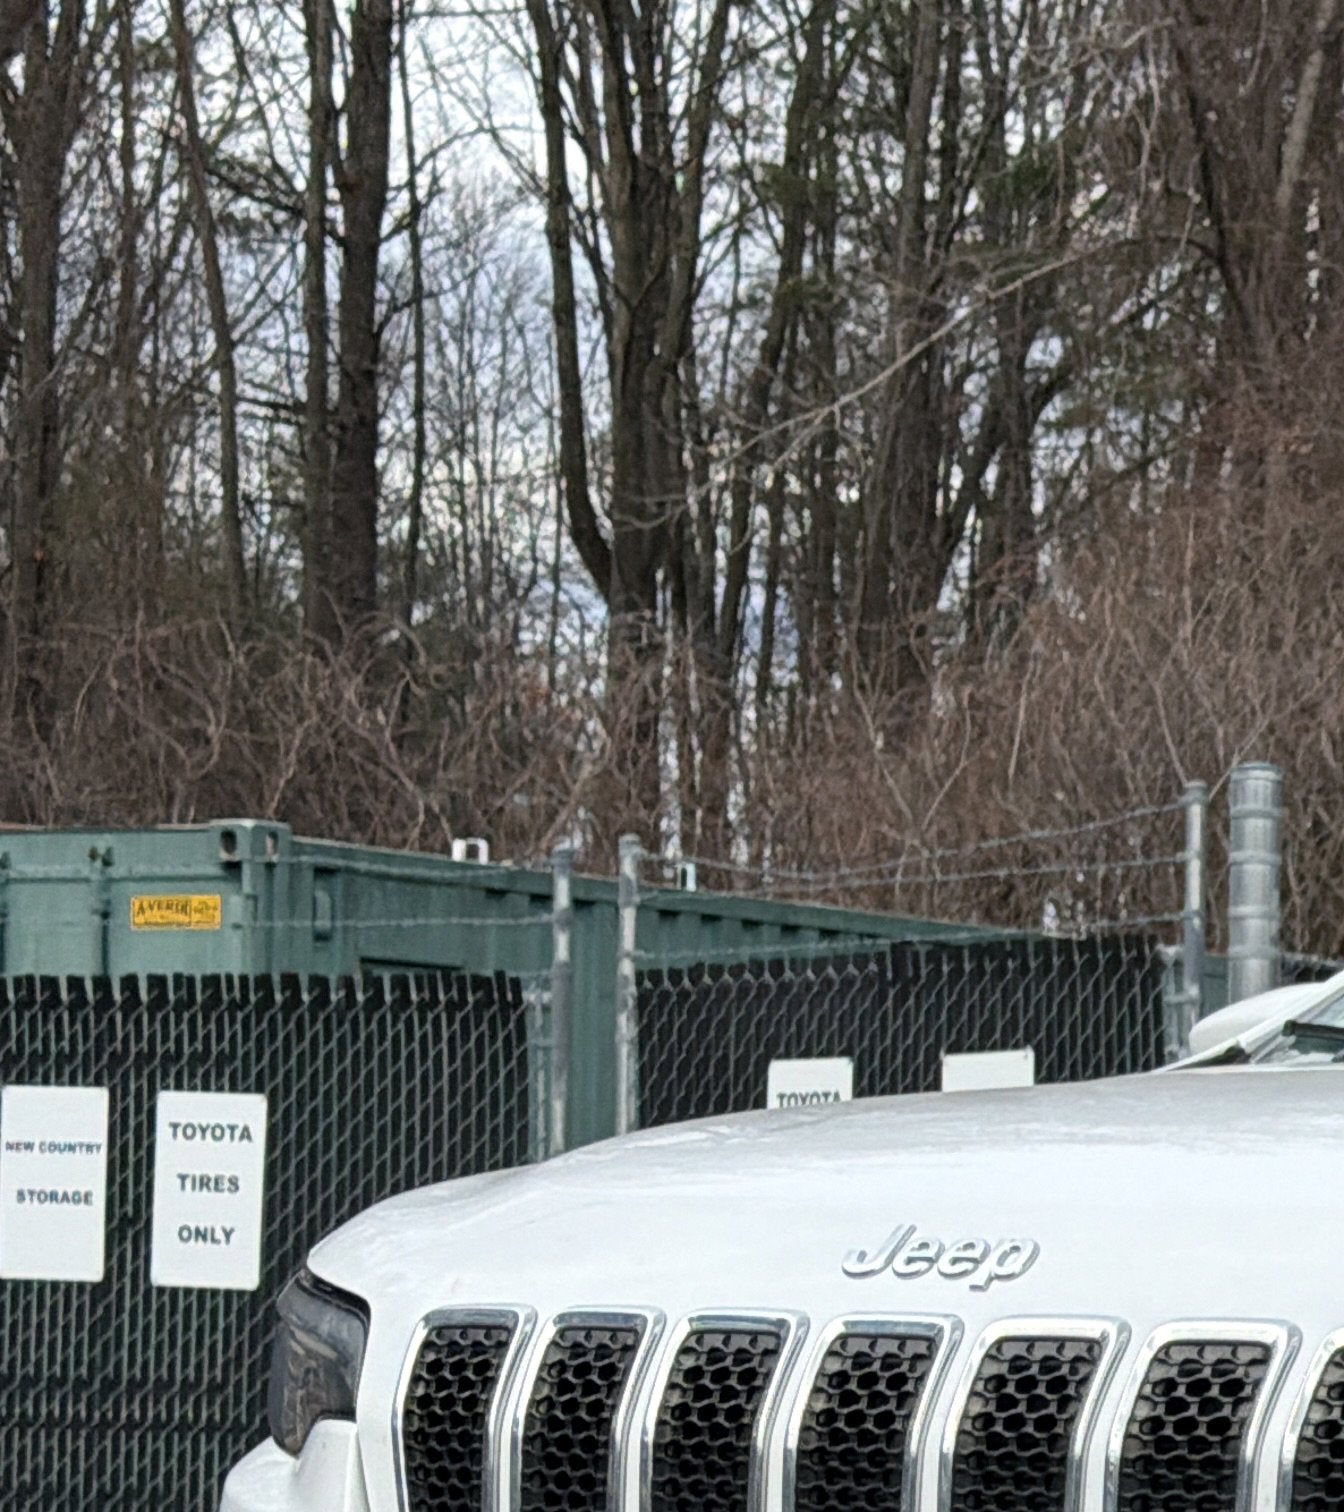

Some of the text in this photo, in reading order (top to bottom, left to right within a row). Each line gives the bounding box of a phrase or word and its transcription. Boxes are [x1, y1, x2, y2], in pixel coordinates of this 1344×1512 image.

[777, 1090, 841, 1108] TOYOTA
[168, 1122, 253, 1143] TOYOTA
[5, 1141, 102, 1155] NEW COUNTRY
[177, 1173, 240, 1194] TIRES
[17, 1189, 93, 1206] STORAGE
[178, 1224, 236, 1245] ONLY
[841, 1224, 1041, 1293] Jeep
